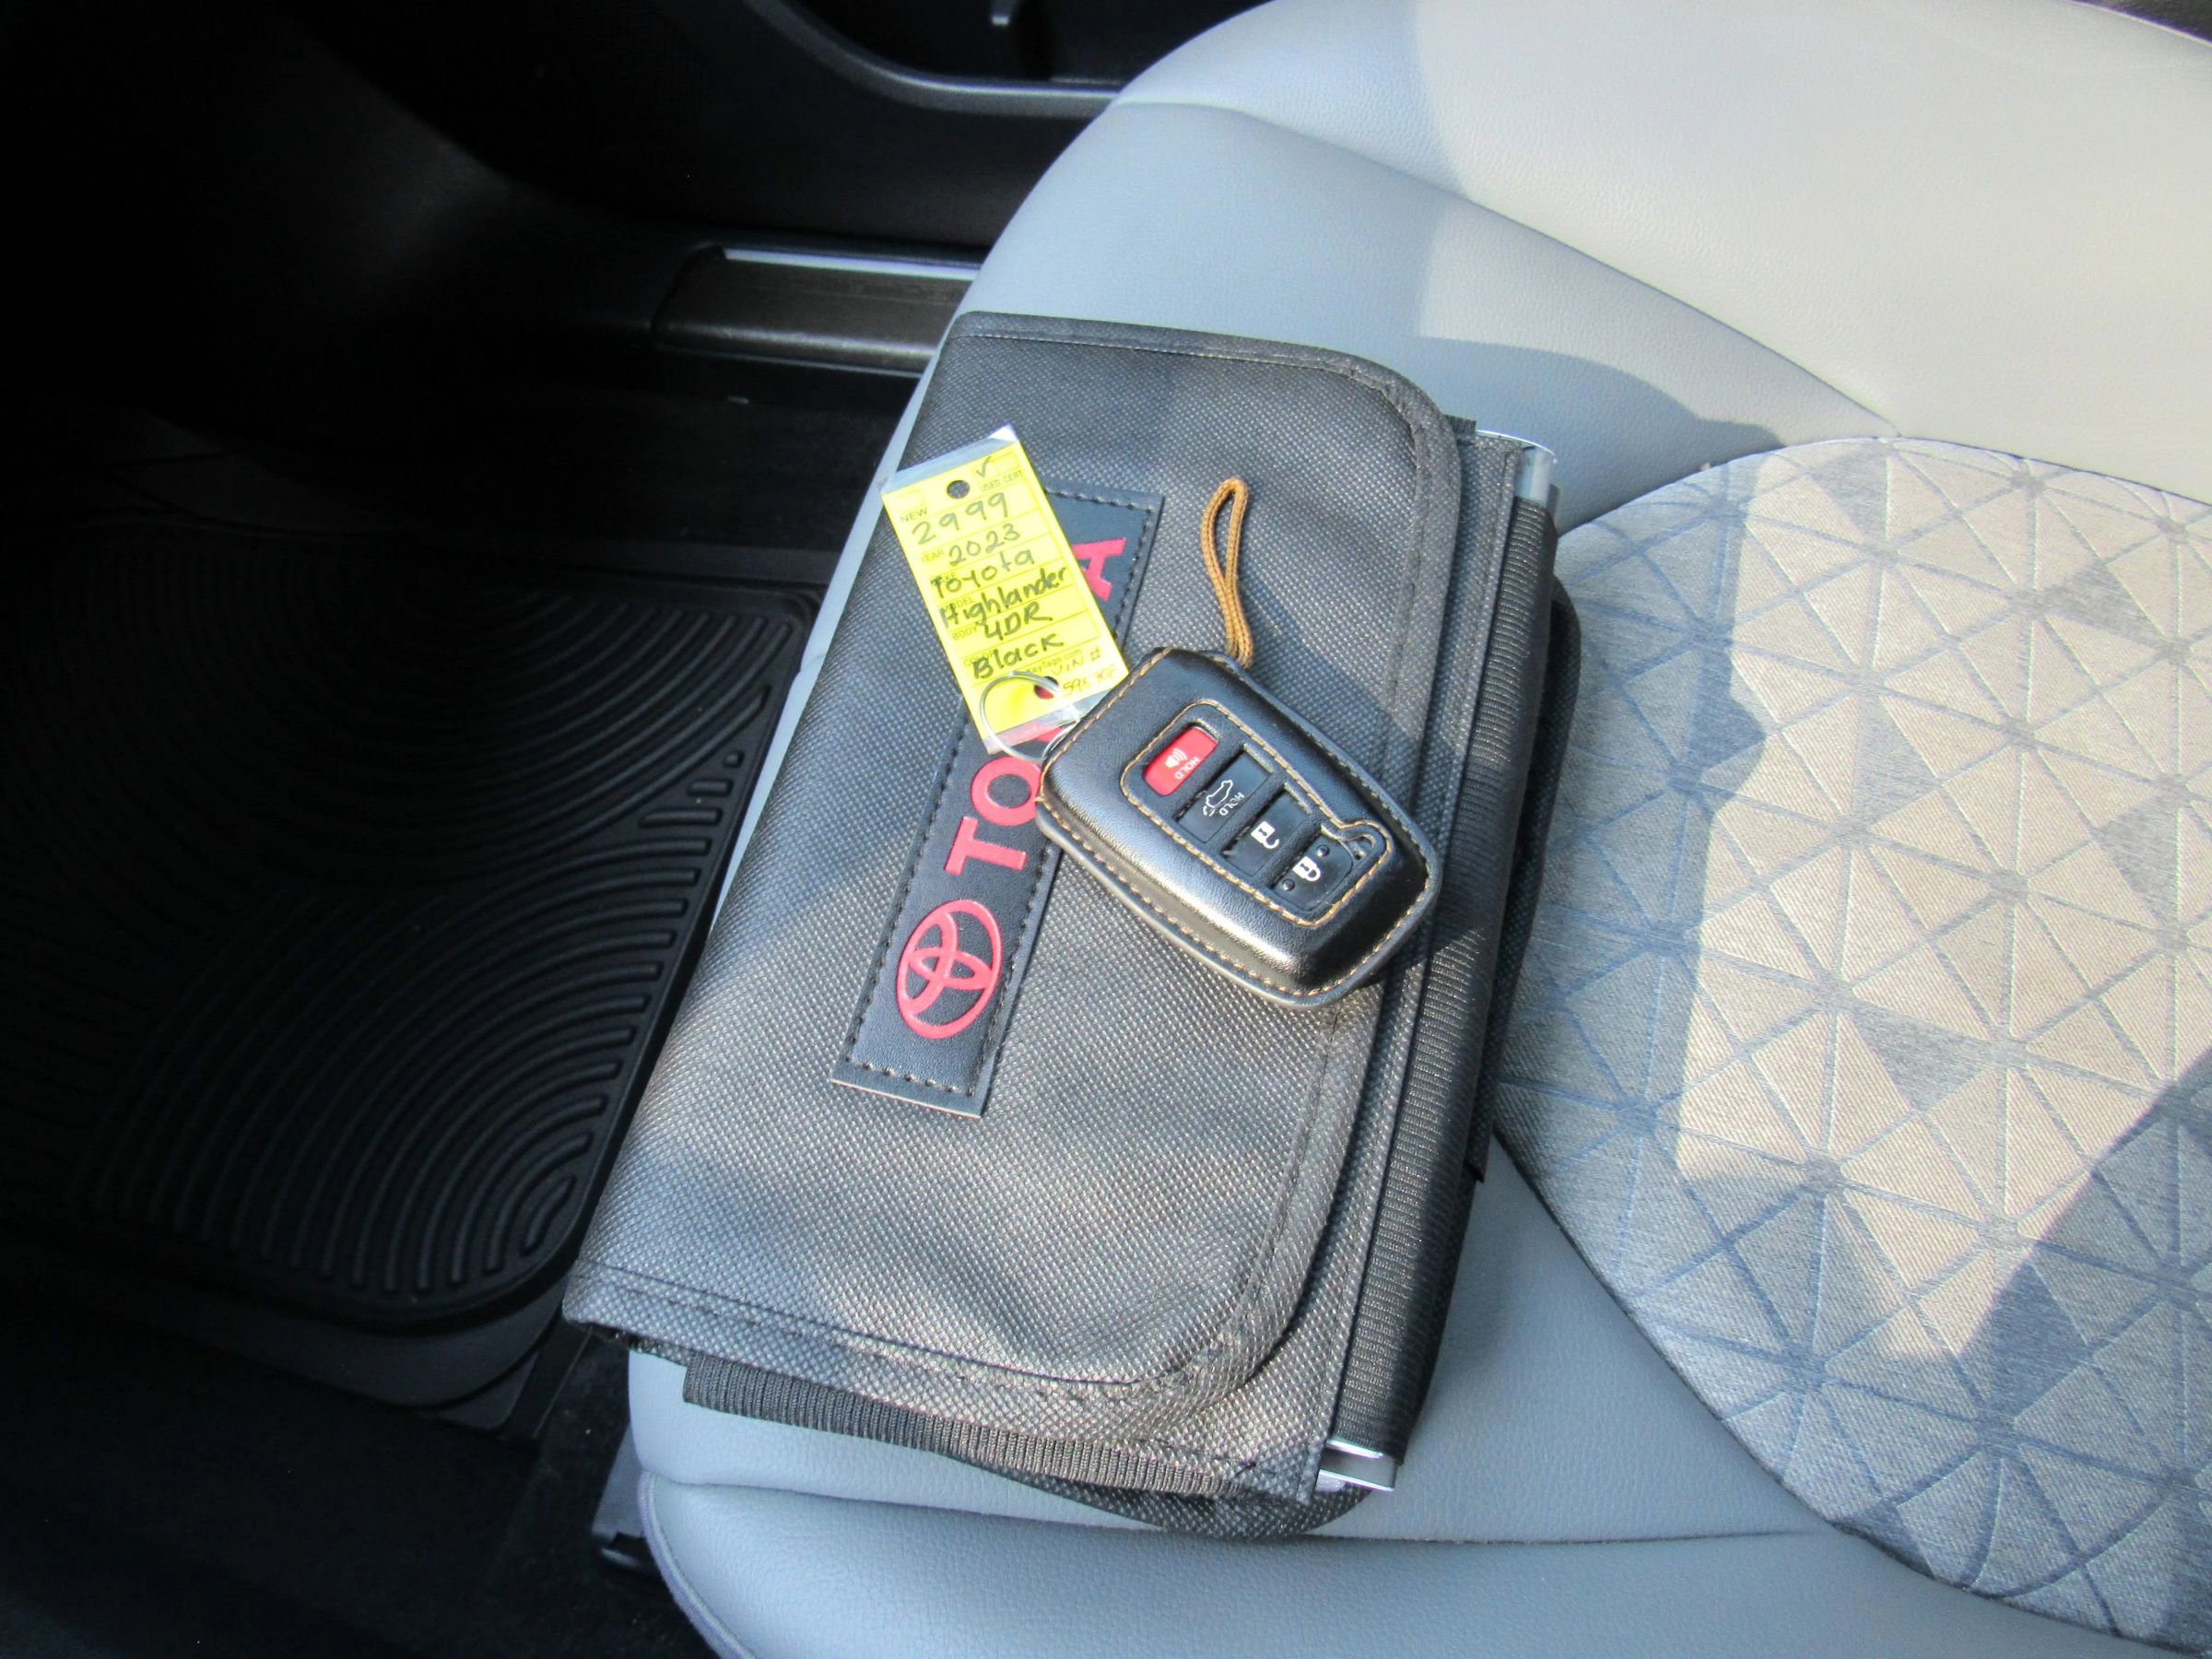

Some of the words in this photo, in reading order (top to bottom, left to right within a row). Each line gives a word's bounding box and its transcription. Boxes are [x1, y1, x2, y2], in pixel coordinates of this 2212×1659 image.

[1002, 468, 1024, 483] CERT
[900, 507, 928, 524] NEW
[912, 492, 1009, 545] 2999
[920, 549, 945, 564] YEAR
[948, 523, 1020, 567] 2023
[930, 549, 1035, 598] Toyota
[940, 567, 1066, 629] Highlander
[951, 624, 979, 641] BODY
[982, 601, 1053, 641] 4DR
[972, 633, 1065, 679] Black
[1174, 756, 1201, 780] HOLD
[1218, 792, 1245, 816] HOLD
